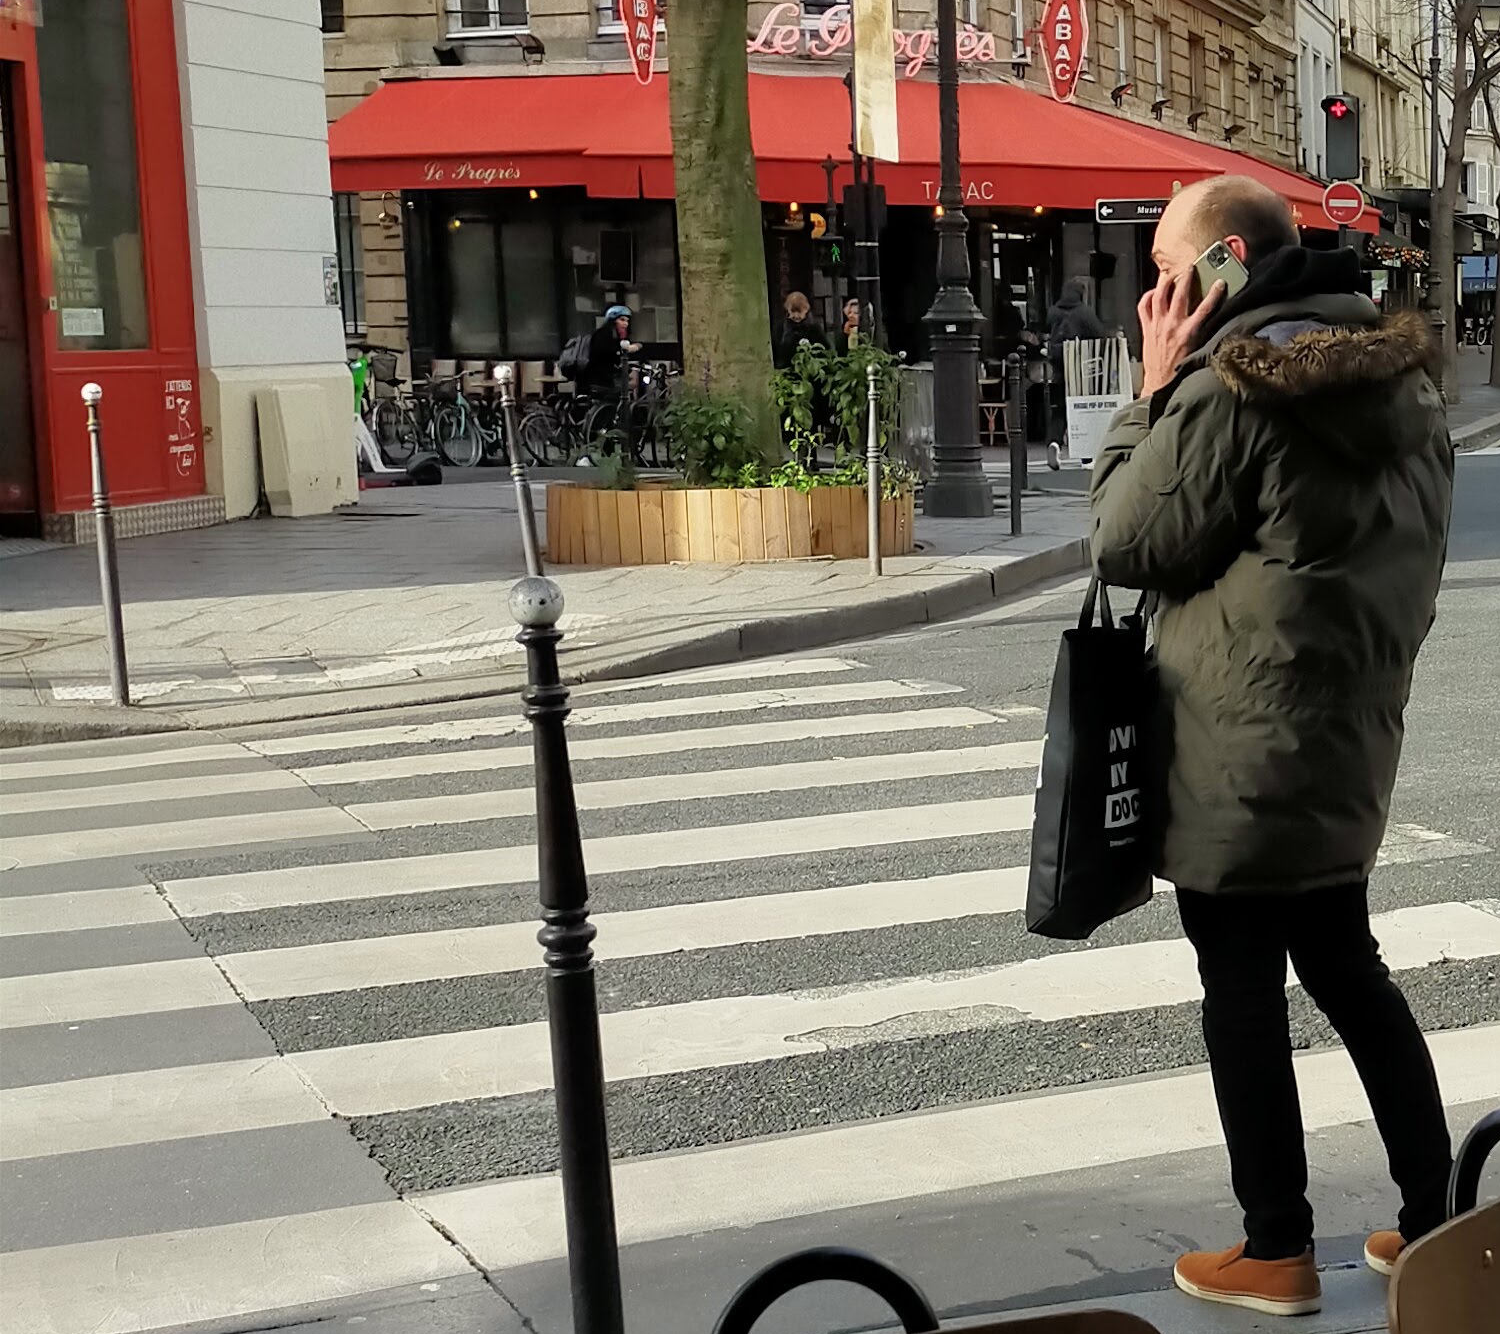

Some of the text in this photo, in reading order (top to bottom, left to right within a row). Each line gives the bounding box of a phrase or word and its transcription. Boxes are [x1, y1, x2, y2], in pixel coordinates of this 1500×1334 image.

[746, 2, 800, 55] Le
[424, 161, 521, 185] Le Progrès
[921, 181, 995, 200] TAC
